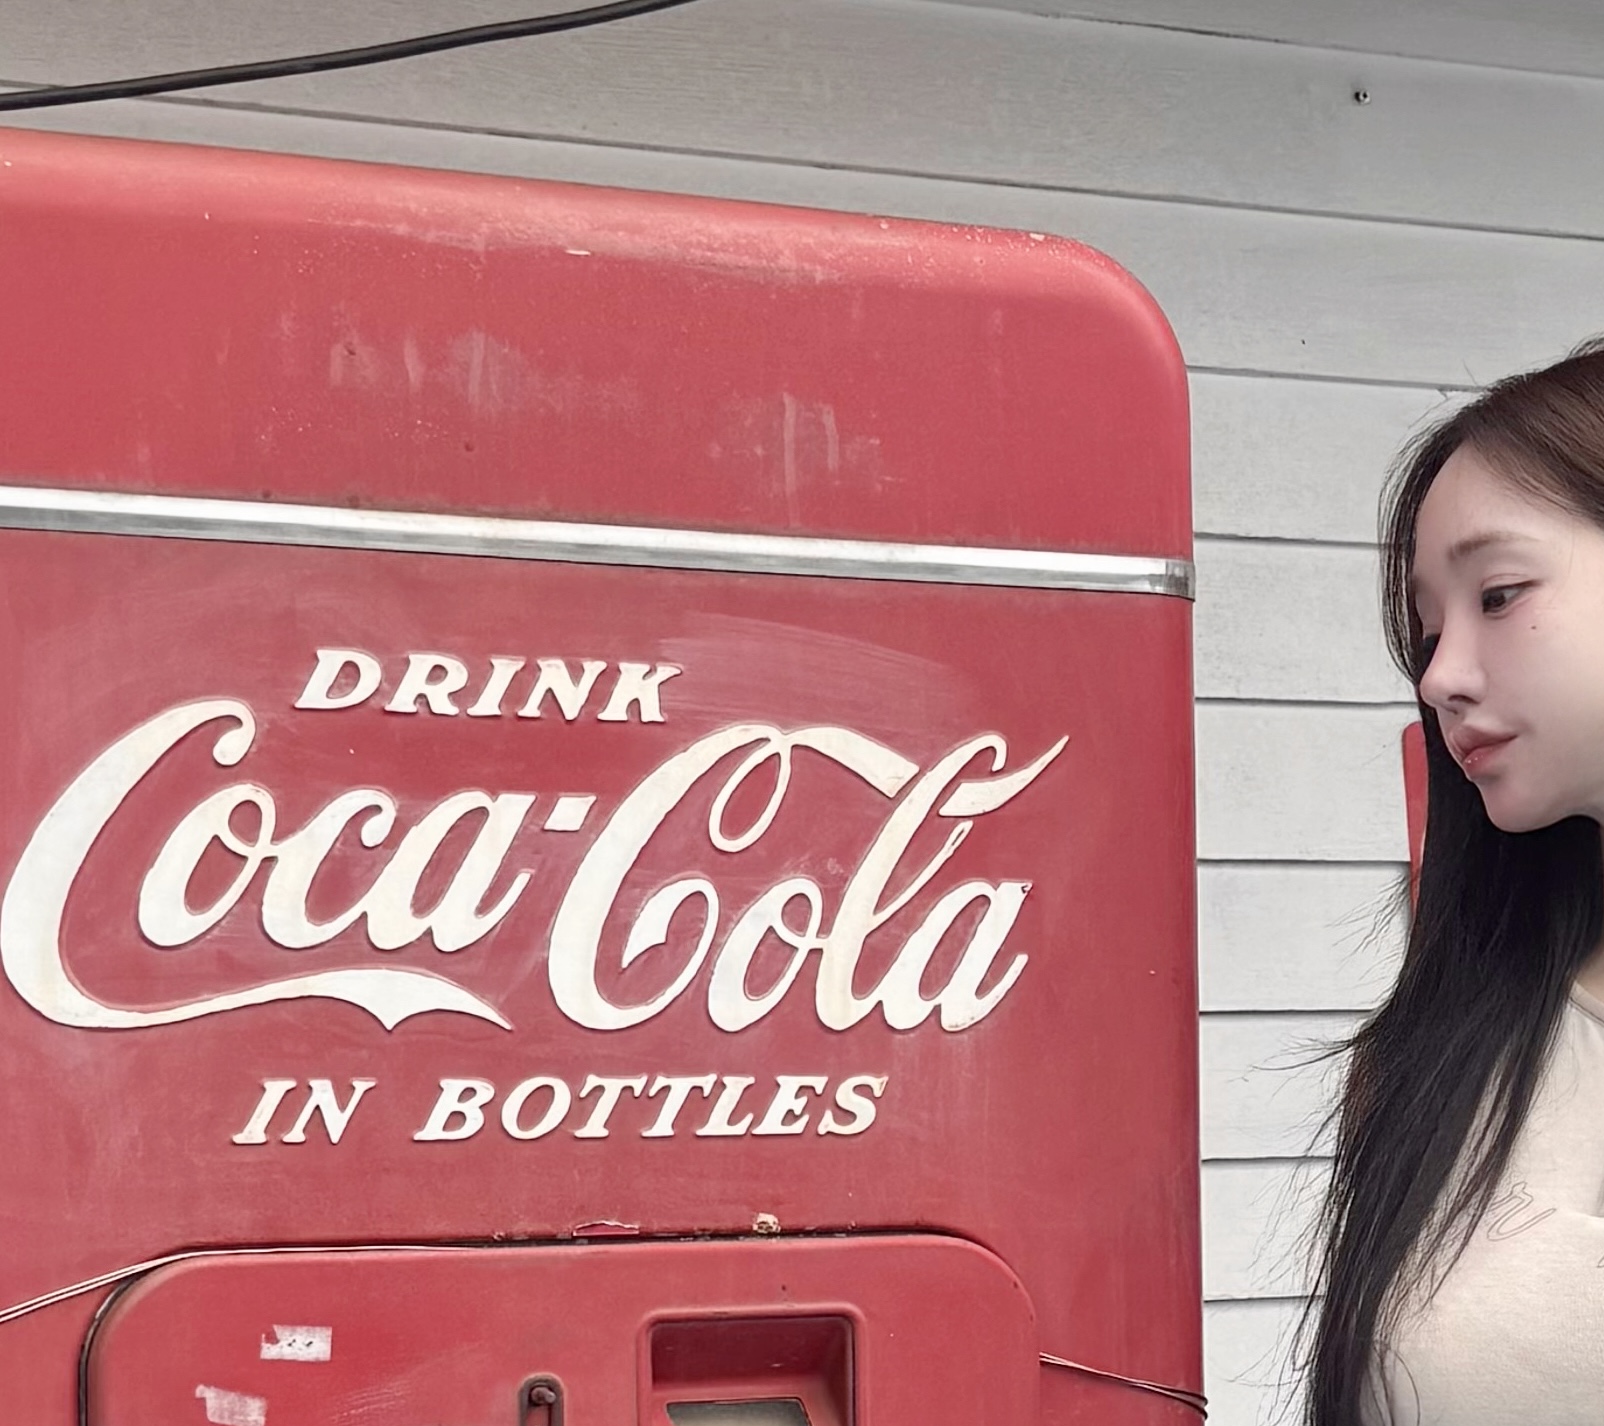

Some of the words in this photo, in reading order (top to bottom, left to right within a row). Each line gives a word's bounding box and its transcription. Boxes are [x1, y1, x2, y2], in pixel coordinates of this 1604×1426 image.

[293, 648, 683, 723] DRINK
[0, 699, 1069, 1033] Coca-Cola
[231, 1076, 376, 1145] IN
[414, 1074, 888, 1143] BOTTLES
